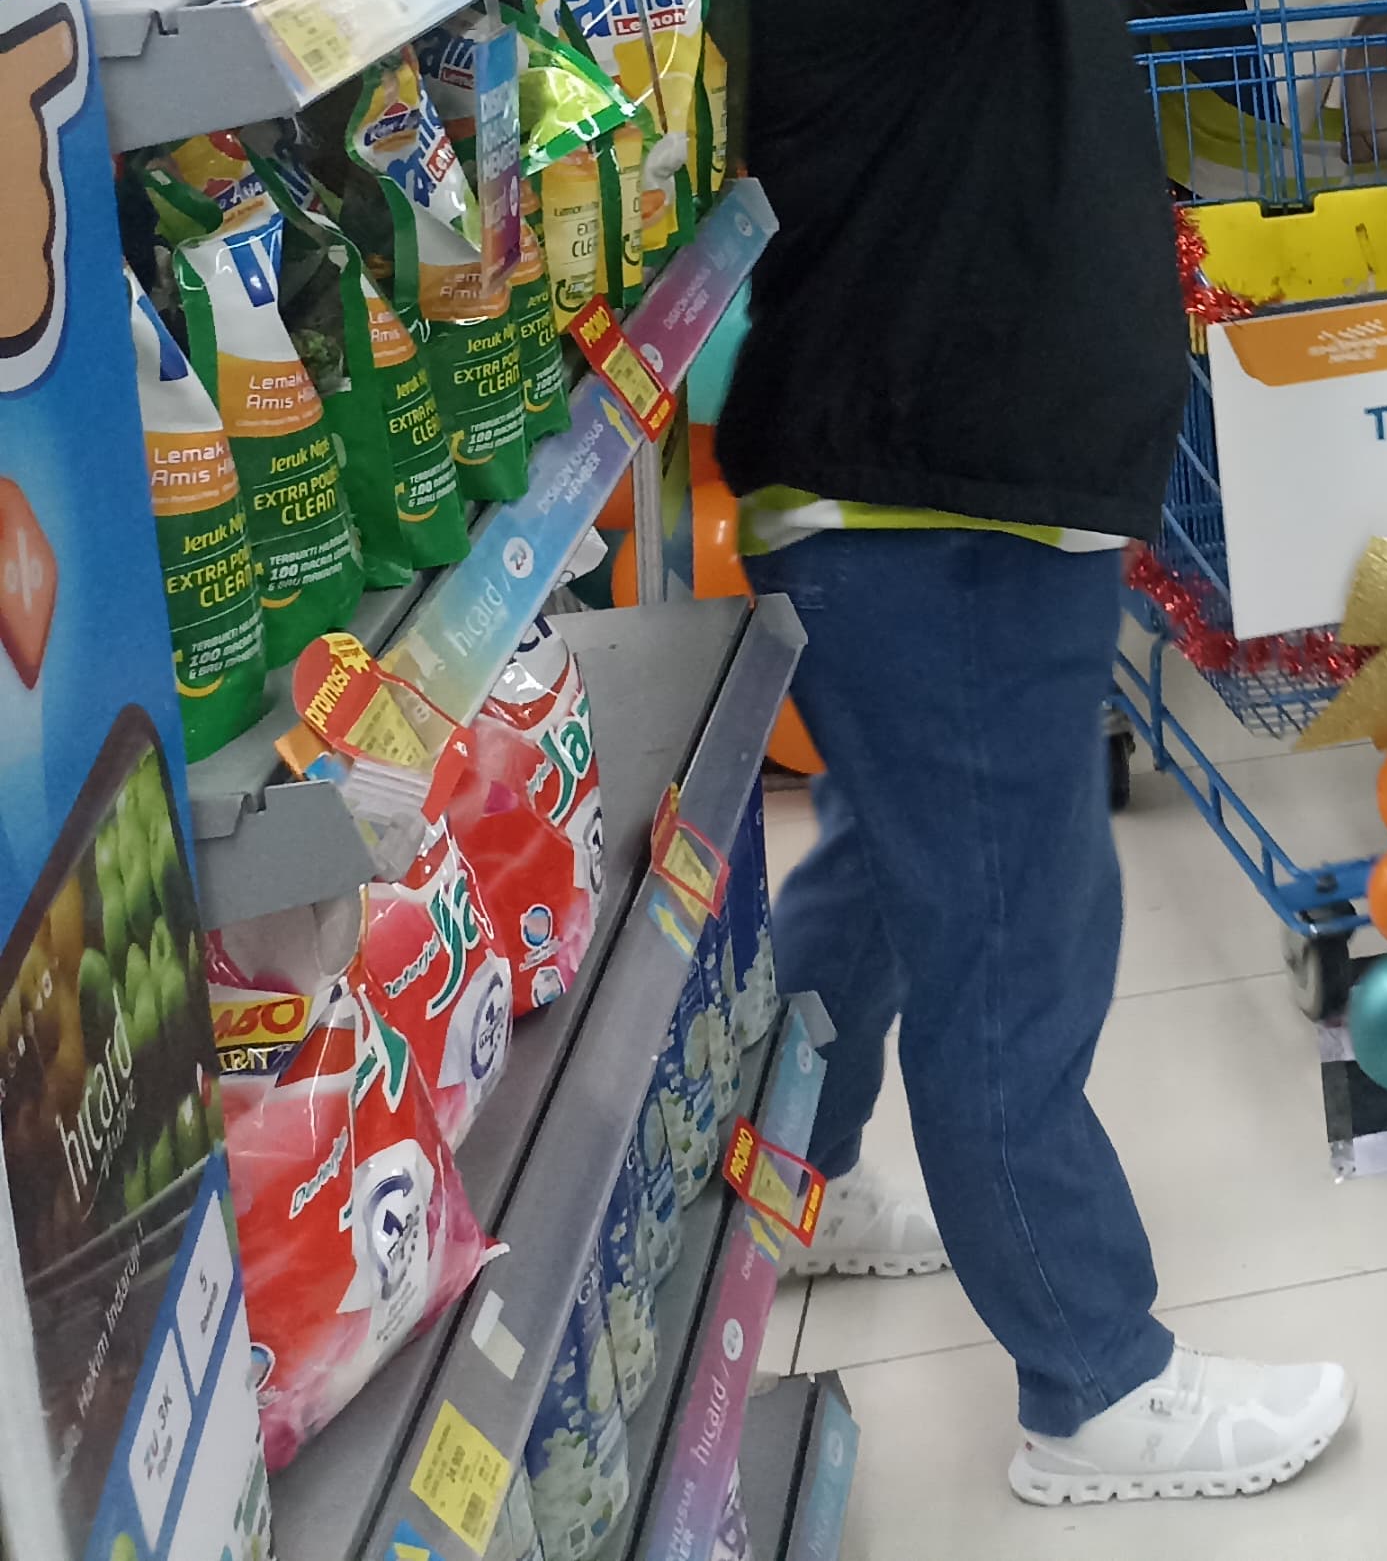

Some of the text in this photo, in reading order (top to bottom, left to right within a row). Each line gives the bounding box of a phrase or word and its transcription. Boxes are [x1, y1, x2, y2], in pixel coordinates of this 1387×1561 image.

[466, 331, 502, 355] Jeruk
[249, 373, 303, 391] Lemak
[453, 358, 500, 385] EXTRA
[246, 395, 295, 412] Amis
[389, 403, 427, 435] EXTRA
[154, 441, 224, 465] Lemak
[270, 448, 309, 475] Jeruk
[151, 468, 211, 487] Amis
[254, 483, 309, 511] EXTRA
[281, 488, 337, 526] CLEAN
[183, 522, 229, 555] Jeruk
[166, 559, 228, 594] EXTRA
[269, 562, 299, 581] 100
[442, 577, 506, 659] hicard
[188, 648, 222, 668] 100
[55, 984, 133, 1206] hicard
[690, 1376, 728, 1466] hicard
